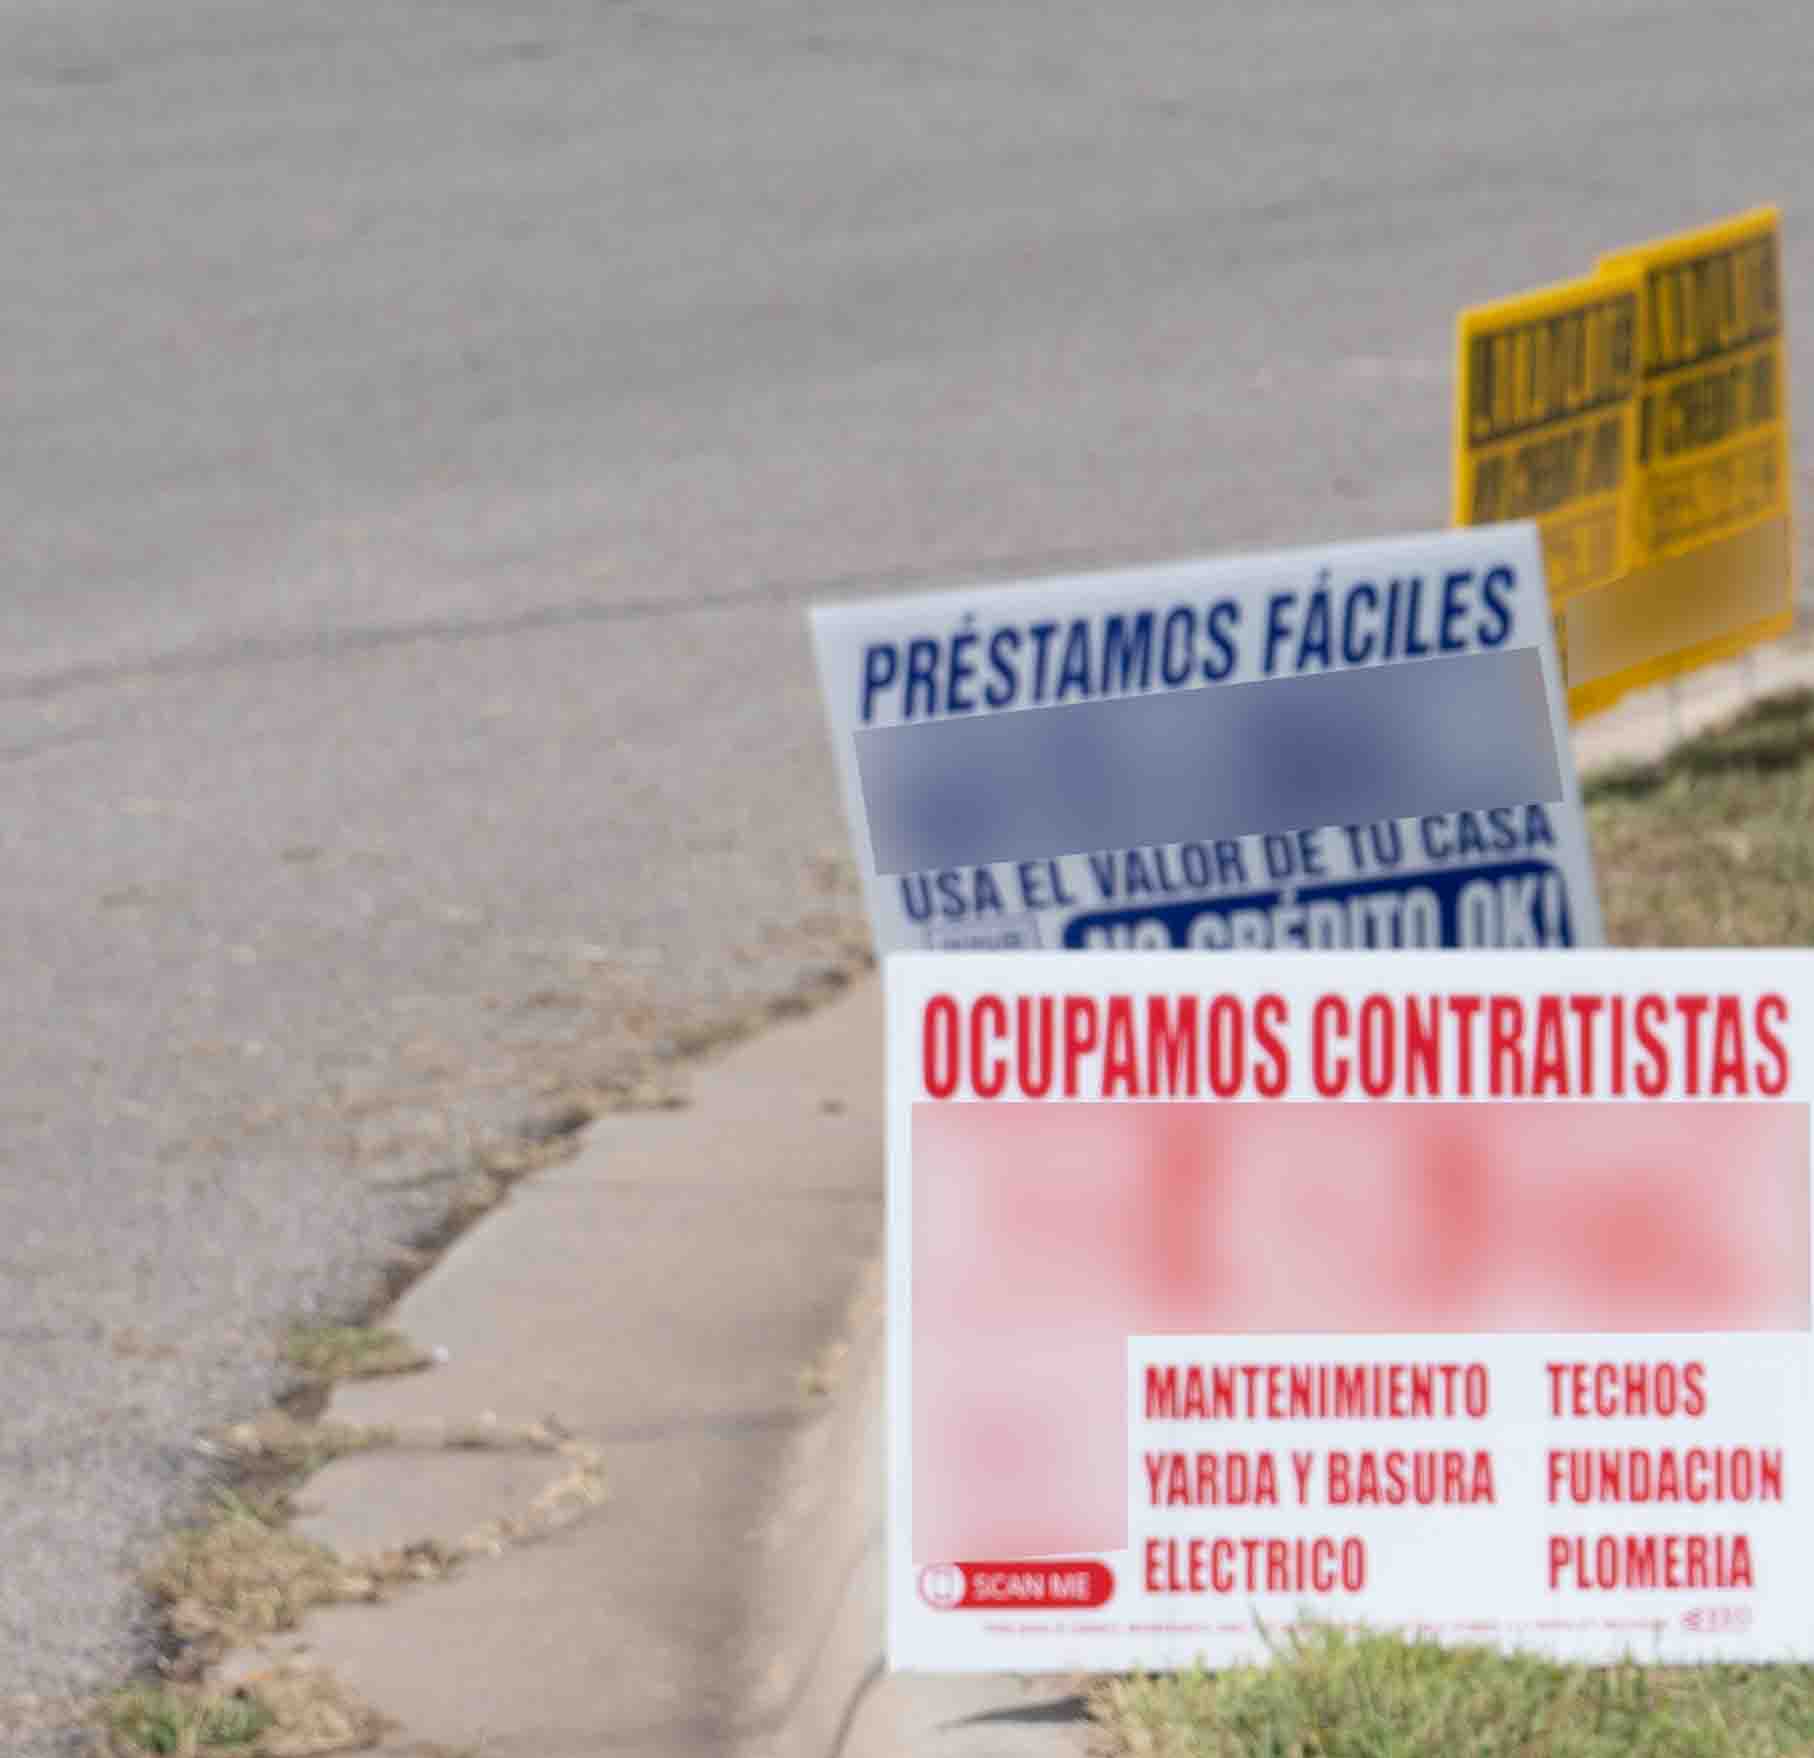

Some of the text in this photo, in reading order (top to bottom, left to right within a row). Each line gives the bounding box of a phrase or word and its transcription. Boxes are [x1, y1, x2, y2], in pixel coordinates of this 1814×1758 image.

[860, 565, 1517, 725] PRÉSTAMOS FÁCILES
[901, 802, 1555, 922] USA EL VALOR DE TU CASA
[922, 992, 1790, 1102] OCUPAMOS CONTRATISTAS
[1143, 1363, 1488, 1420] MANTENIMIENTO
[1546, 1361, 1706, 1418] TECHOS
[1144, 1449, 1495, 1506] YARDA Y BASURA
[1546, 1447, 1783, 1505] FUNDACION
[973, 1570, 1091, 1600] SCAN ME
[1143, 1536, 1366, 1594] ELECTRICO
[1548, 1534, 1753, 1590] PLOMERIA
